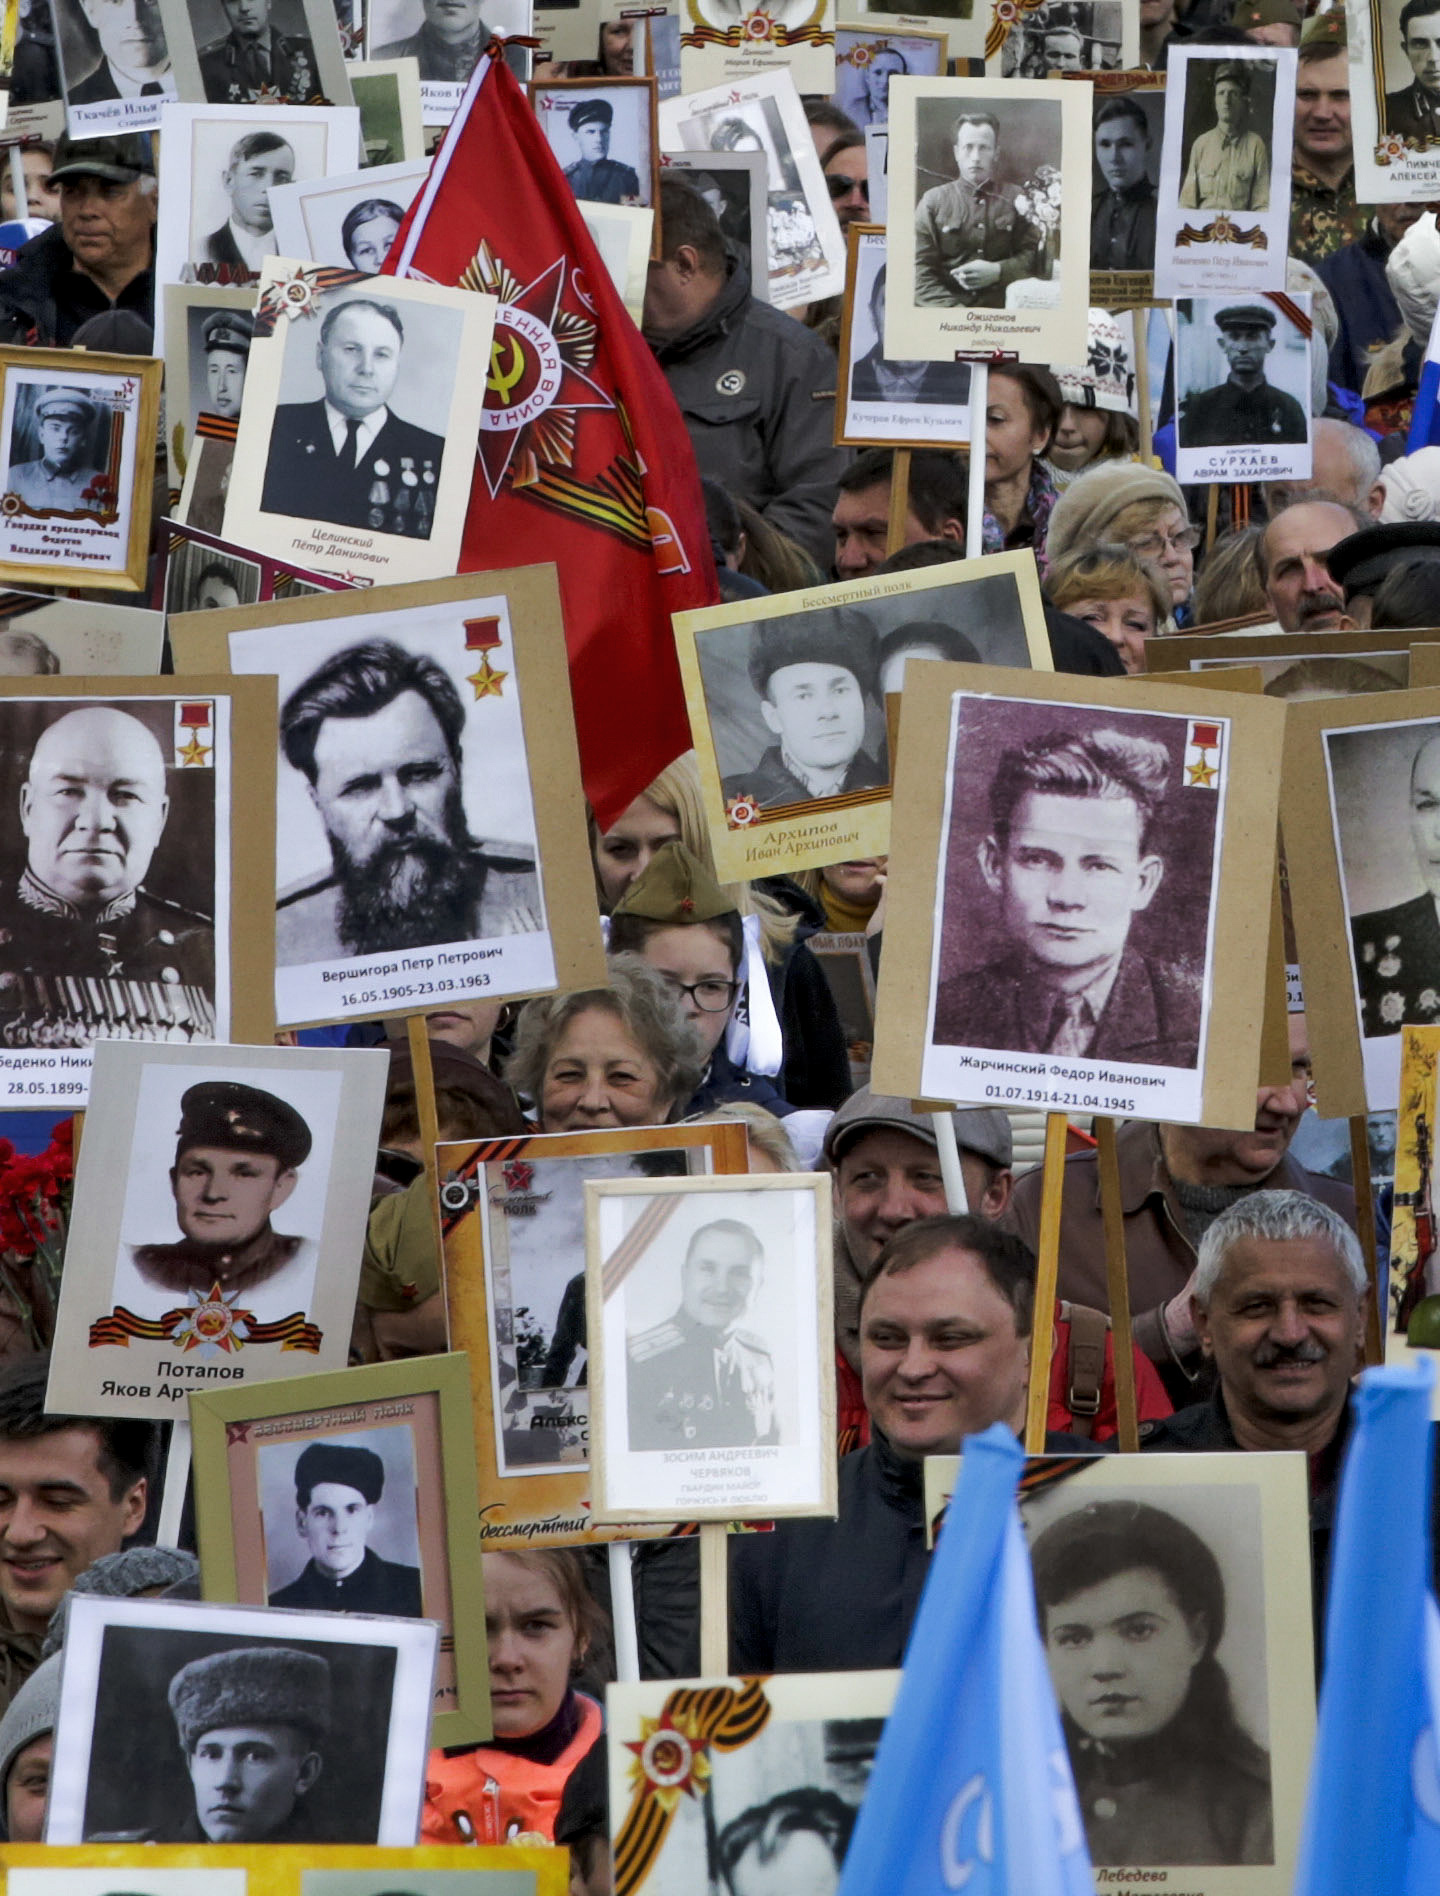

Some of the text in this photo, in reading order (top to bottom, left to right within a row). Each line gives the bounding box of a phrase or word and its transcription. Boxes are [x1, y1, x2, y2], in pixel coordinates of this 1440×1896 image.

[420, 89, 455, 98] Яков
[124, 104, 157, 119] Илья
[1390, 169, 1435, 181] АЛЕКСЕЙ
[966, 310, 1017, 324] Ожиганов
[939, 321, 1042, 337] Никандр Николаевич
[1193, 464, 1293, 477] АВРАМ ЗАХАРОВИЧ
[1209, 455, 1279, 468] СУРХАЕВ
[311, 526, 374, 549] Целинский
[291, 538, 389, 566] Пётр Данилович
[801, 579, 913, 610] Бессмертный полк
[763, 820, 839, 845] Архипов
[744, 831, 861, 863] Иван Архипович
[321, 945, 504, 984] Вершигора Петр Петрович
[340, 973, 491, 1007] 16.05.1905-23.03.1963
[959, 1055, 1167, 1090] Жарчинский Федор Иванович
[985, 1085, 1136, 1112] 01.07.1914-21.04.1945
[503, 1204, 537, 1216] ПОЛК
[157, 1360, 245, 1380] Потапов
[101, 1379, 151, 1398] Яков
[253, 1401, 415, 1439] БЕССМЕРТНЫЙ ПОЛК
[662, 1447, 779, 1465] ЗОСИМ АНДРЕЕВИЧ
[690, 1466, 752, 1479] ЧЕРВЯКОВ
[478, 1504, 589, 1543] бессмертный
[1096, 1868, 1168, 1884] Лебедева
